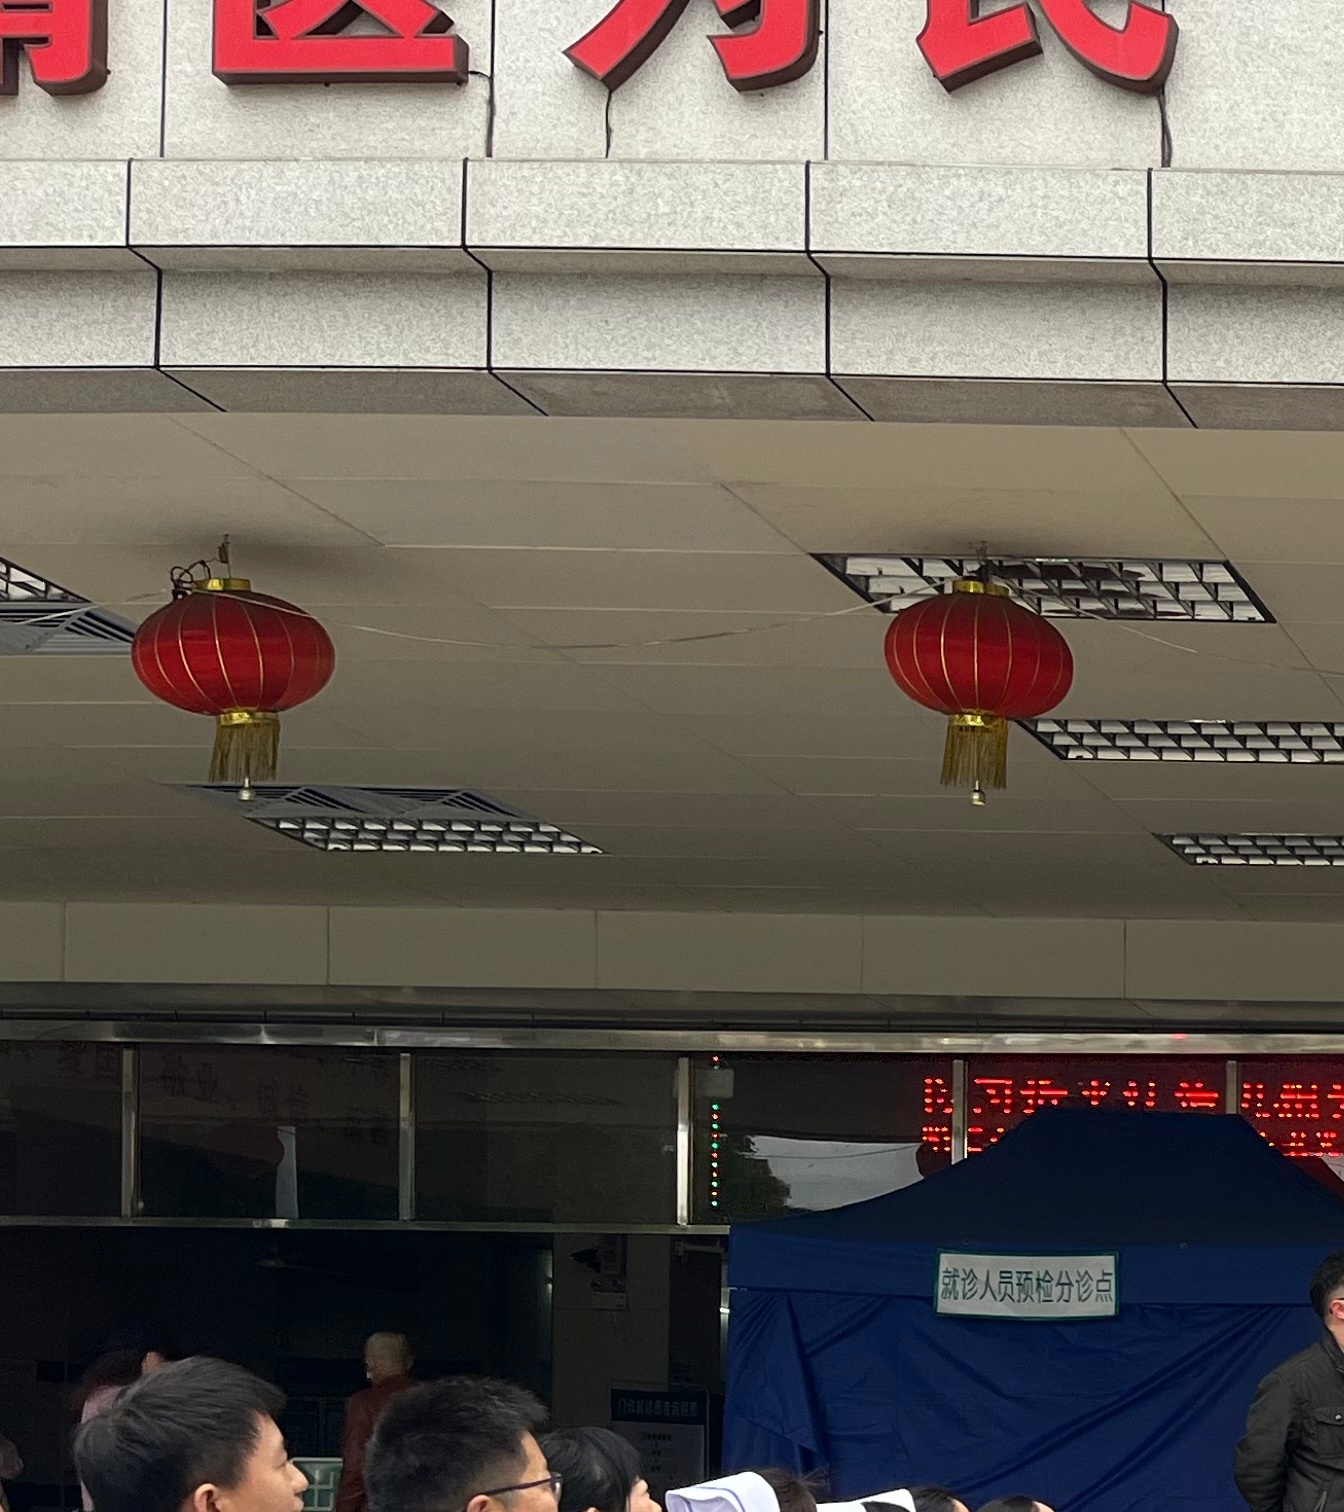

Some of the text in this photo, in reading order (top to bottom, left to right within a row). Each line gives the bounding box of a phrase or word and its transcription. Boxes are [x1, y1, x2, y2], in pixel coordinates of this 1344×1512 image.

[940, 1266, 1114, 1303] 就诊人员预检分诊点
